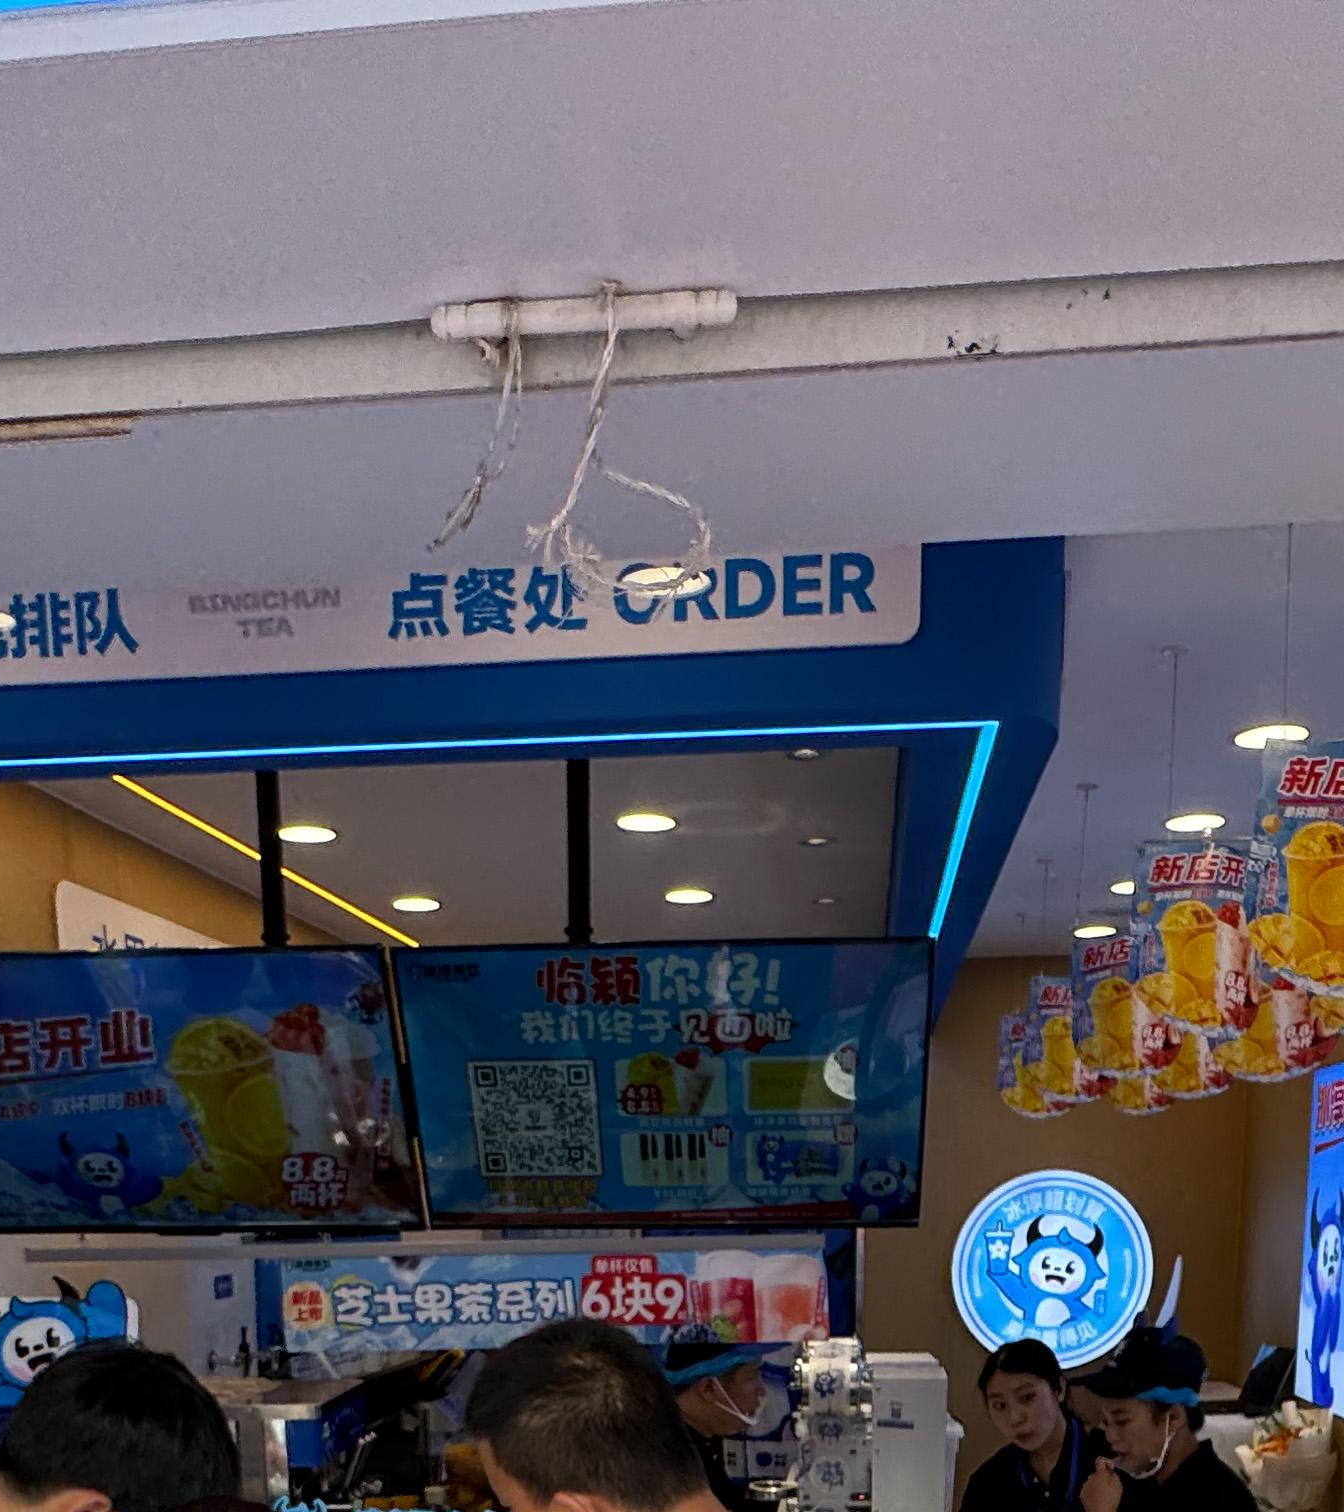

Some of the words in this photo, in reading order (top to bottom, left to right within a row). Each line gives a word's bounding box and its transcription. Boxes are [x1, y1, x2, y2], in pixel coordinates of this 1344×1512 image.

[388, 562, 588, 641] 点餐处
[237, 616, 295, 640] TEA
[520, 1006, 794, 1044] 我们终于见面啦
[289, 1182, 348, 1208] 两杯
[333, 1278, 575, 1328] 芝士果茶系列
